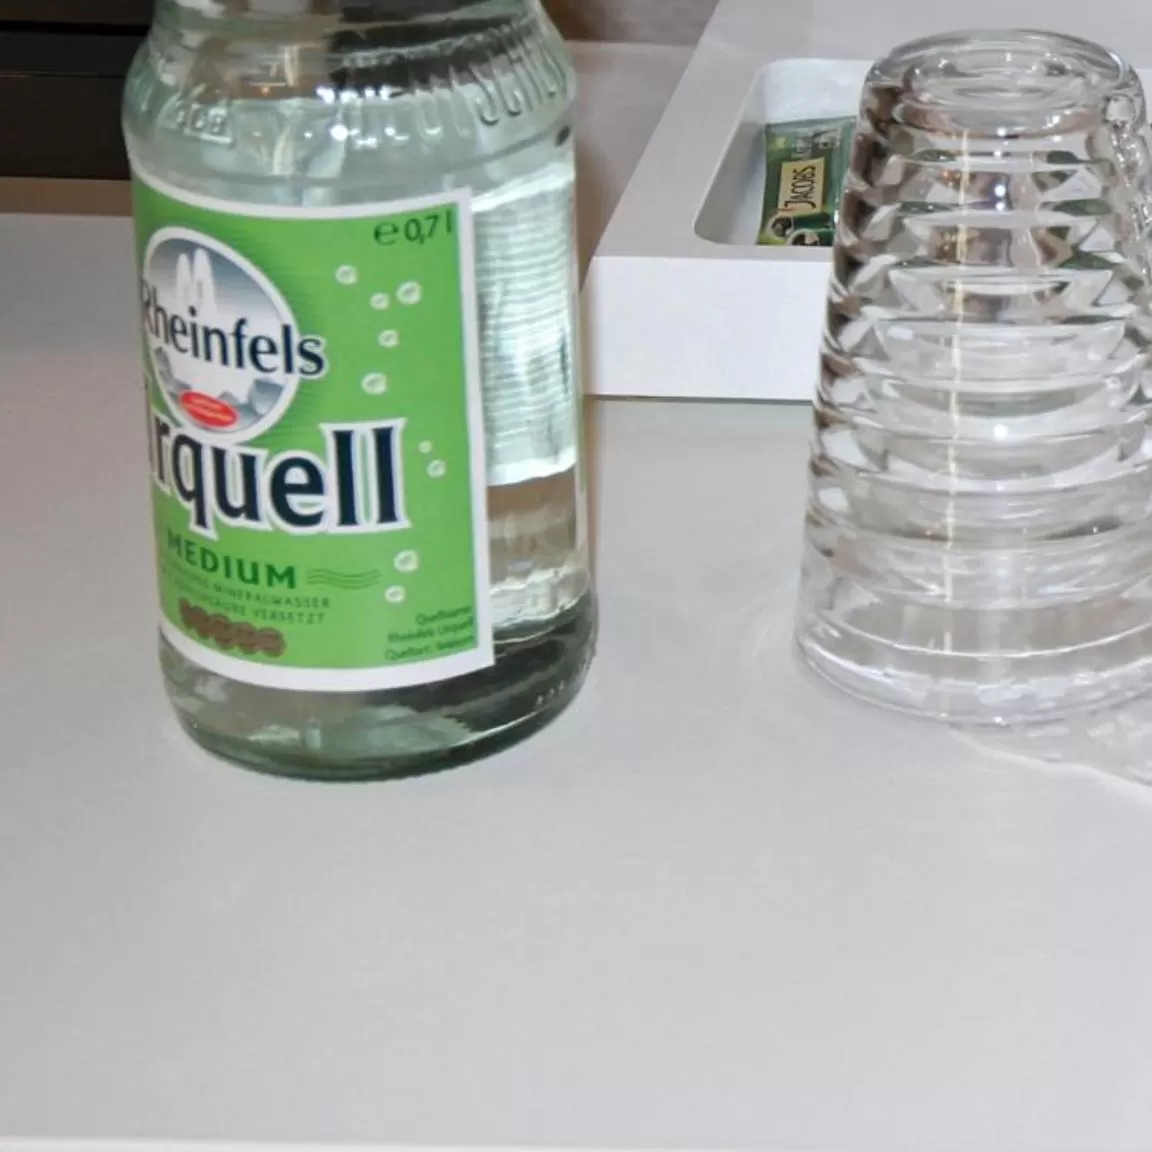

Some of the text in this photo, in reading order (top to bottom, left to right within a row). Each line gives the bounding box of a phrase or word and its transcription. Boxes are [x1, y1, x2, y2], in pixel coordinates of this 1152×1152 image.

[783, 164, 817, 209] JACOBS
[140, 277, 326, 377] Rheinfels
[148, 413, 400, 531] rquell
[167, 529, 297, 590] MEDIUM
